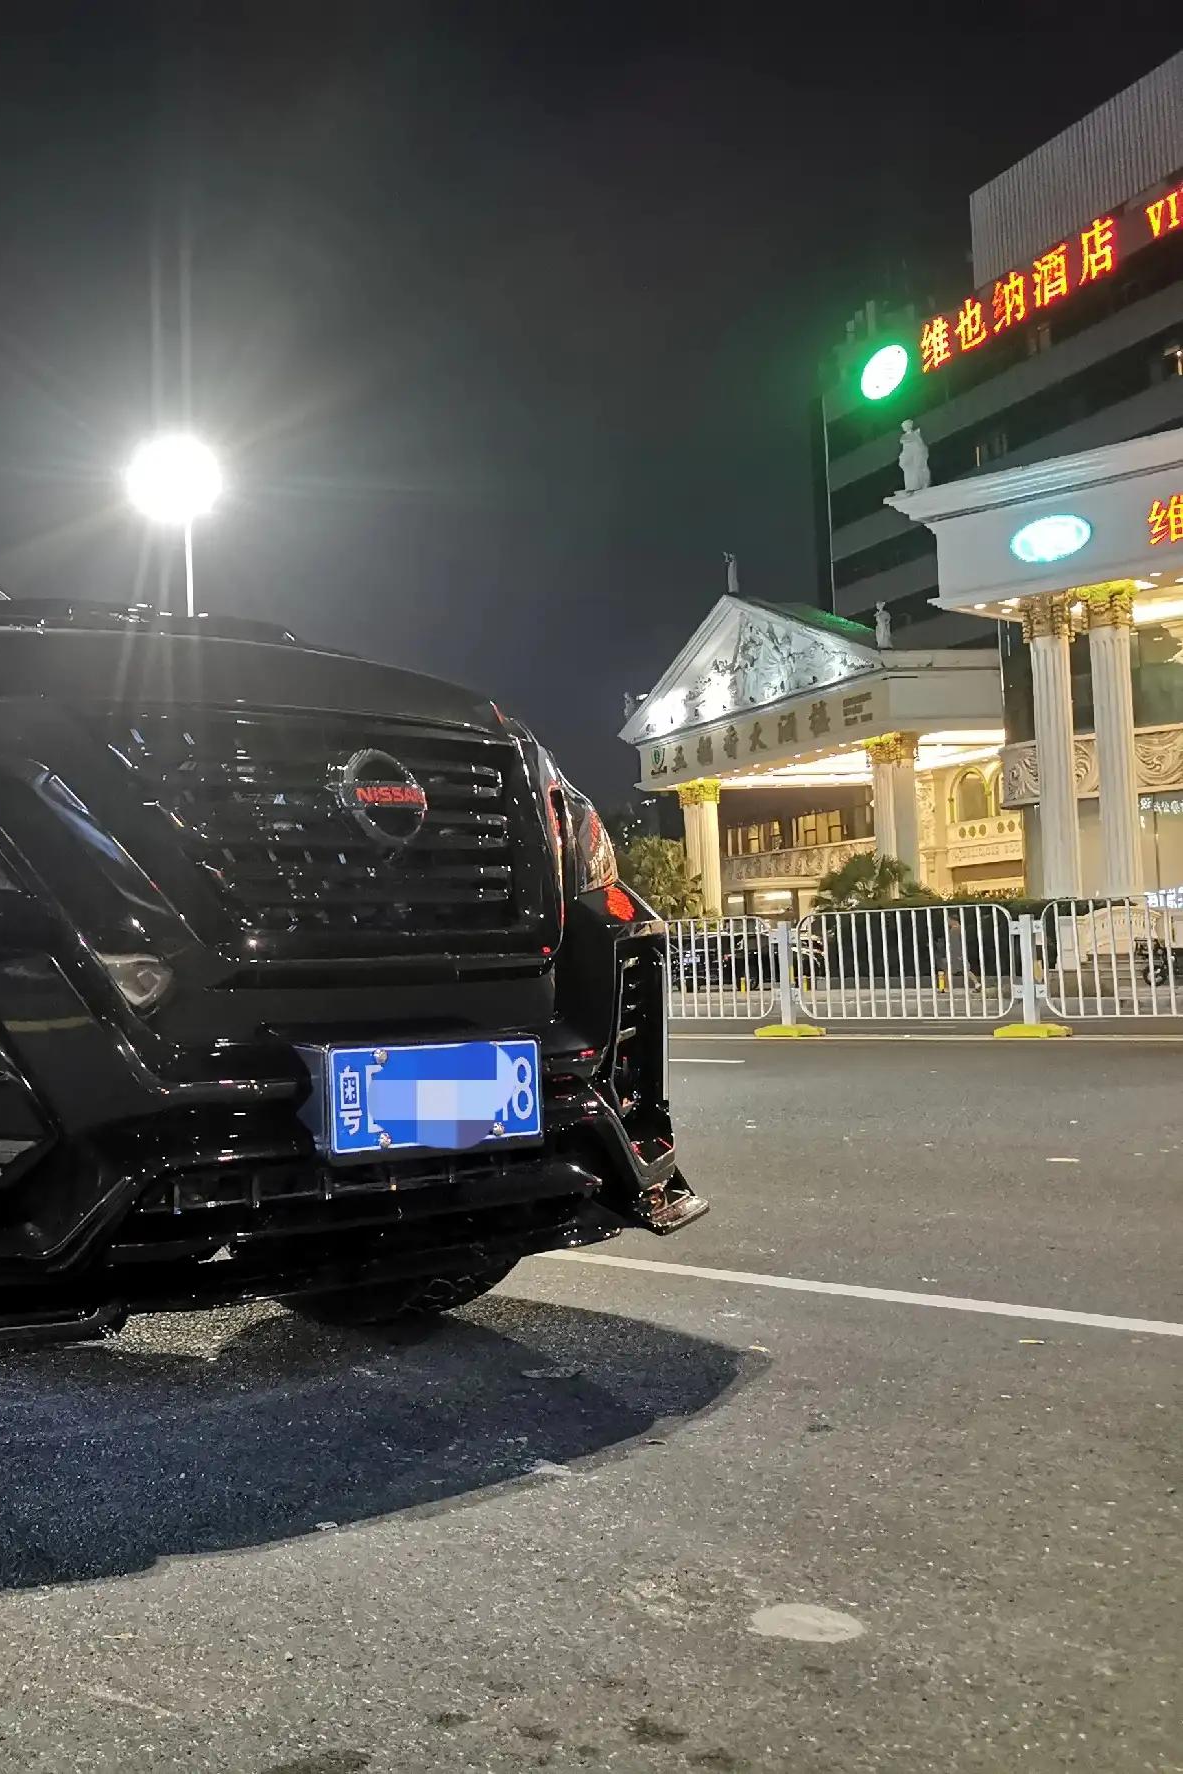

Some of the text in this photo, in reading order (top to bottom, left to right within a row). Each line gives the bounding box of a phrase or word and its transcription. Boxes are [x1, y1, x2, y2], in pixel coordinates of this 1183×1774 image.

[920, 186, 1183, 373] 维也纳酒店 VI
